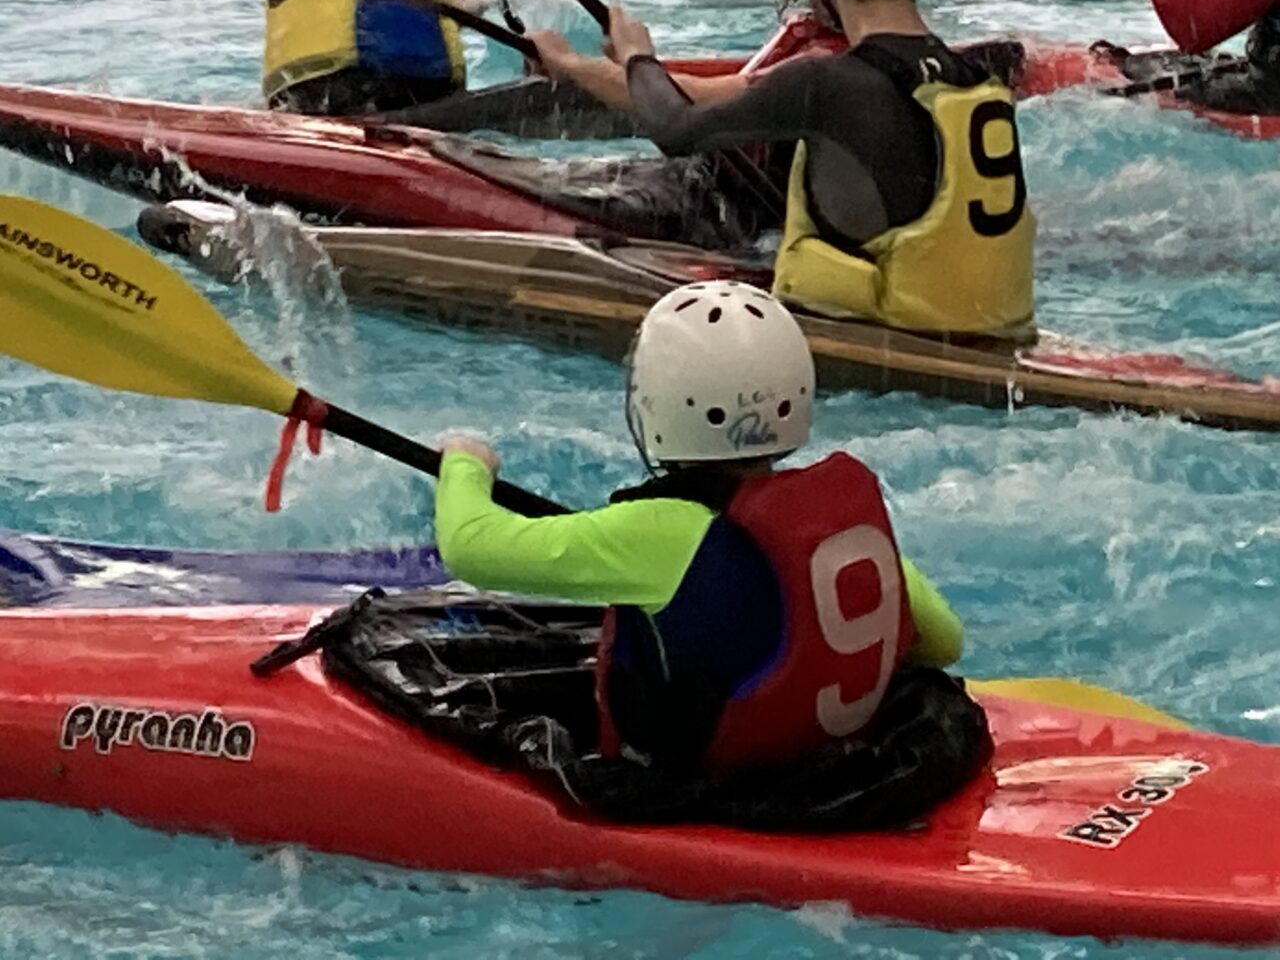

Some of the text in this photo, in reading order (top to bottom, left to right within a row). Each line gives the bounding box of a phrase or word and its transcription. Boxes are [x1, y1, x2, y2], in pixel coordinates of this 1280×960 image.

[968, 100, 1027, 237] 9
[811, 524, 902, 738] 9
[61, 703, 255, 760] pyranha
[1061, 803, 1149, 847] RX
